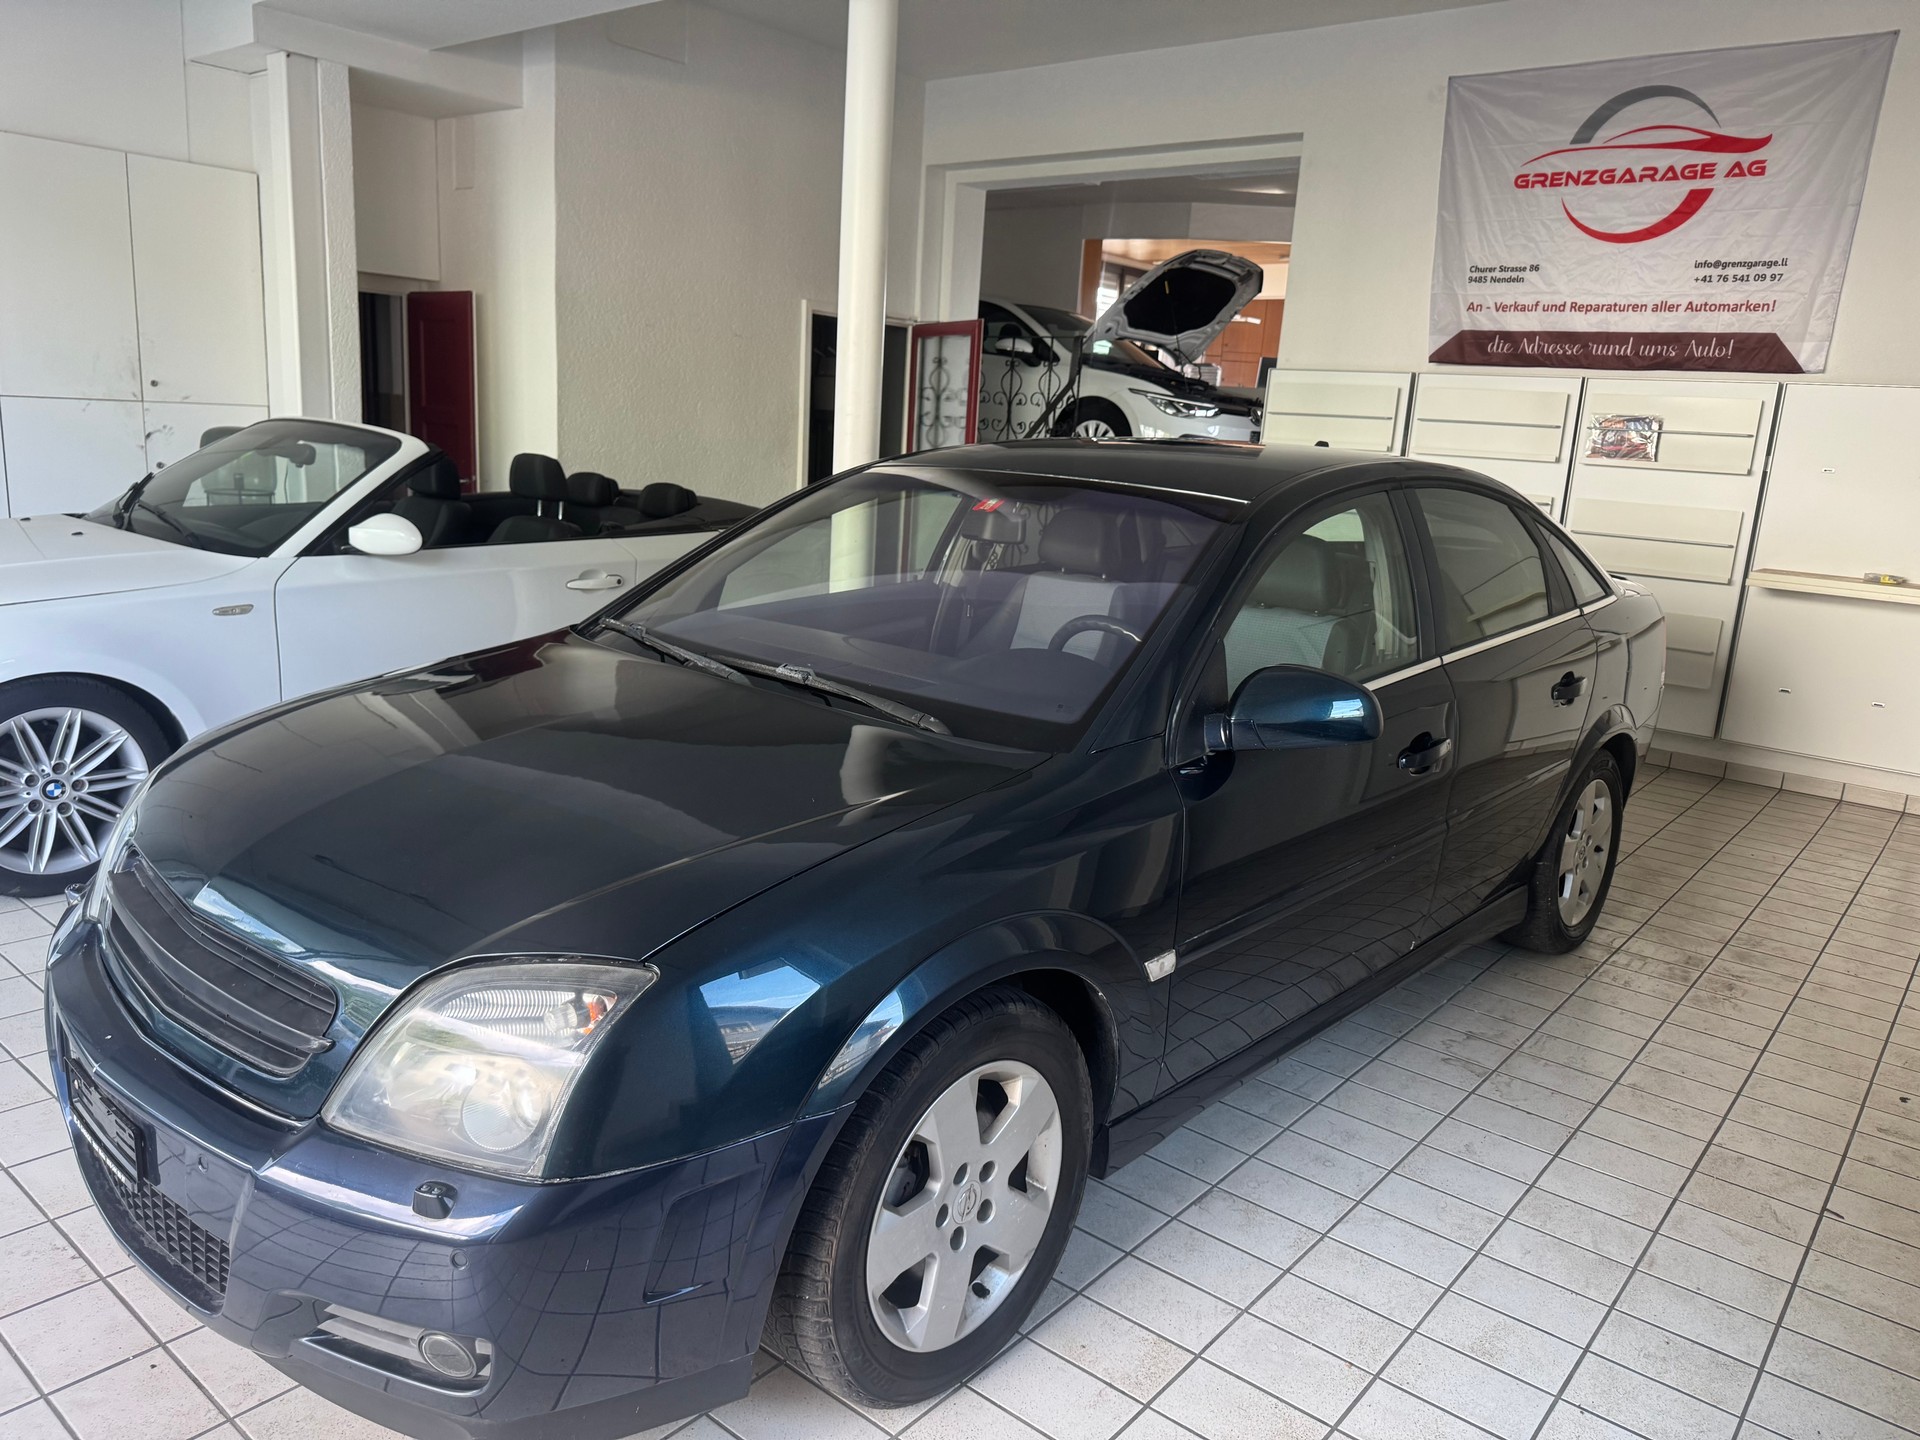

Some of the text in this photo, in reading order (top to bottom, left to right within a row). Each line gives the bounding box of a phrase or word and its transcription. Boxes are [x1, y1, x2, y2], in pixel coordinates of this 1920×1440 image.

[1514, 159, 1768, 189] GRENZGARAGE AG
[1469, 264, 1540, 274] Churer Strasse 86
[1694, 257, 1788, 270] info@grenzgarage.li
[1467, 275, 1525, 284] 9485 Nendeln
[1693, 273, 1784, 283] +41 76 541 09 97
[1466, 301, 1483, 312] An
[1494, 301, 1541, 313] Verkauf
[1542, 301, 1566, 313] und
[1569, 301, 1648, 315] Reparaturen
[1651, 300, 1682, 312] aller
[1684, 300, 1777, 312] Automarken!
[1487, 334, 1514, 354] die
[1517, 335, 1584, 356] Adresse
[1588, 336, 1636, 357] rund
[1638, 343, 1680, 357] ums
